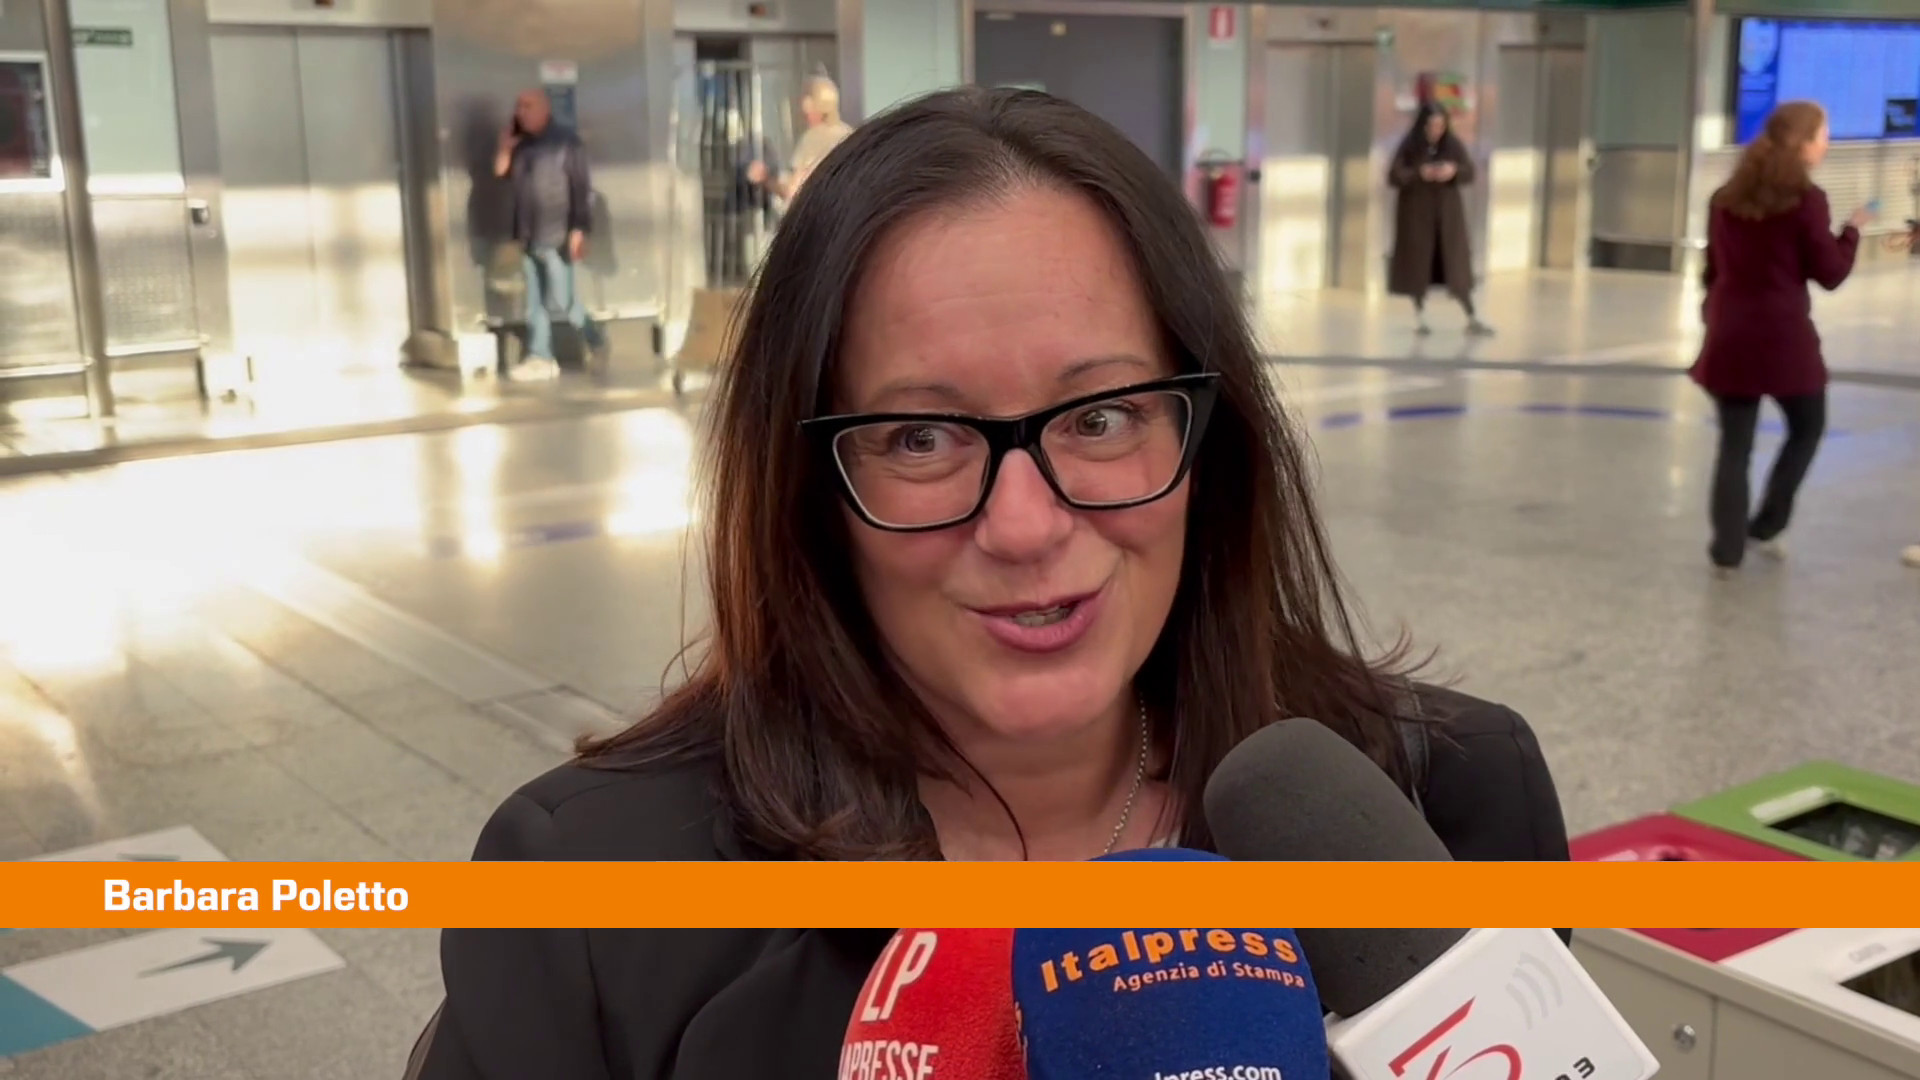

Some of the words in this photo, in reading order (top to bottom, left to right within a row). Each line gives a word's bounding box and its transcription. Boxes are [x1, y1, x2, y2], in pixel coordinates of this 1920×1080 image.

[860, 931, 938, 1022] LP
[1041, 929, 1298, 992] Italpress
[1114, 961, 1200, 992] Agenzia
[1207, 960, 1227, 977] di
[1232, 961, 1305, 988] Stampa
[838, 1040, 939, 1080] APRESSE
